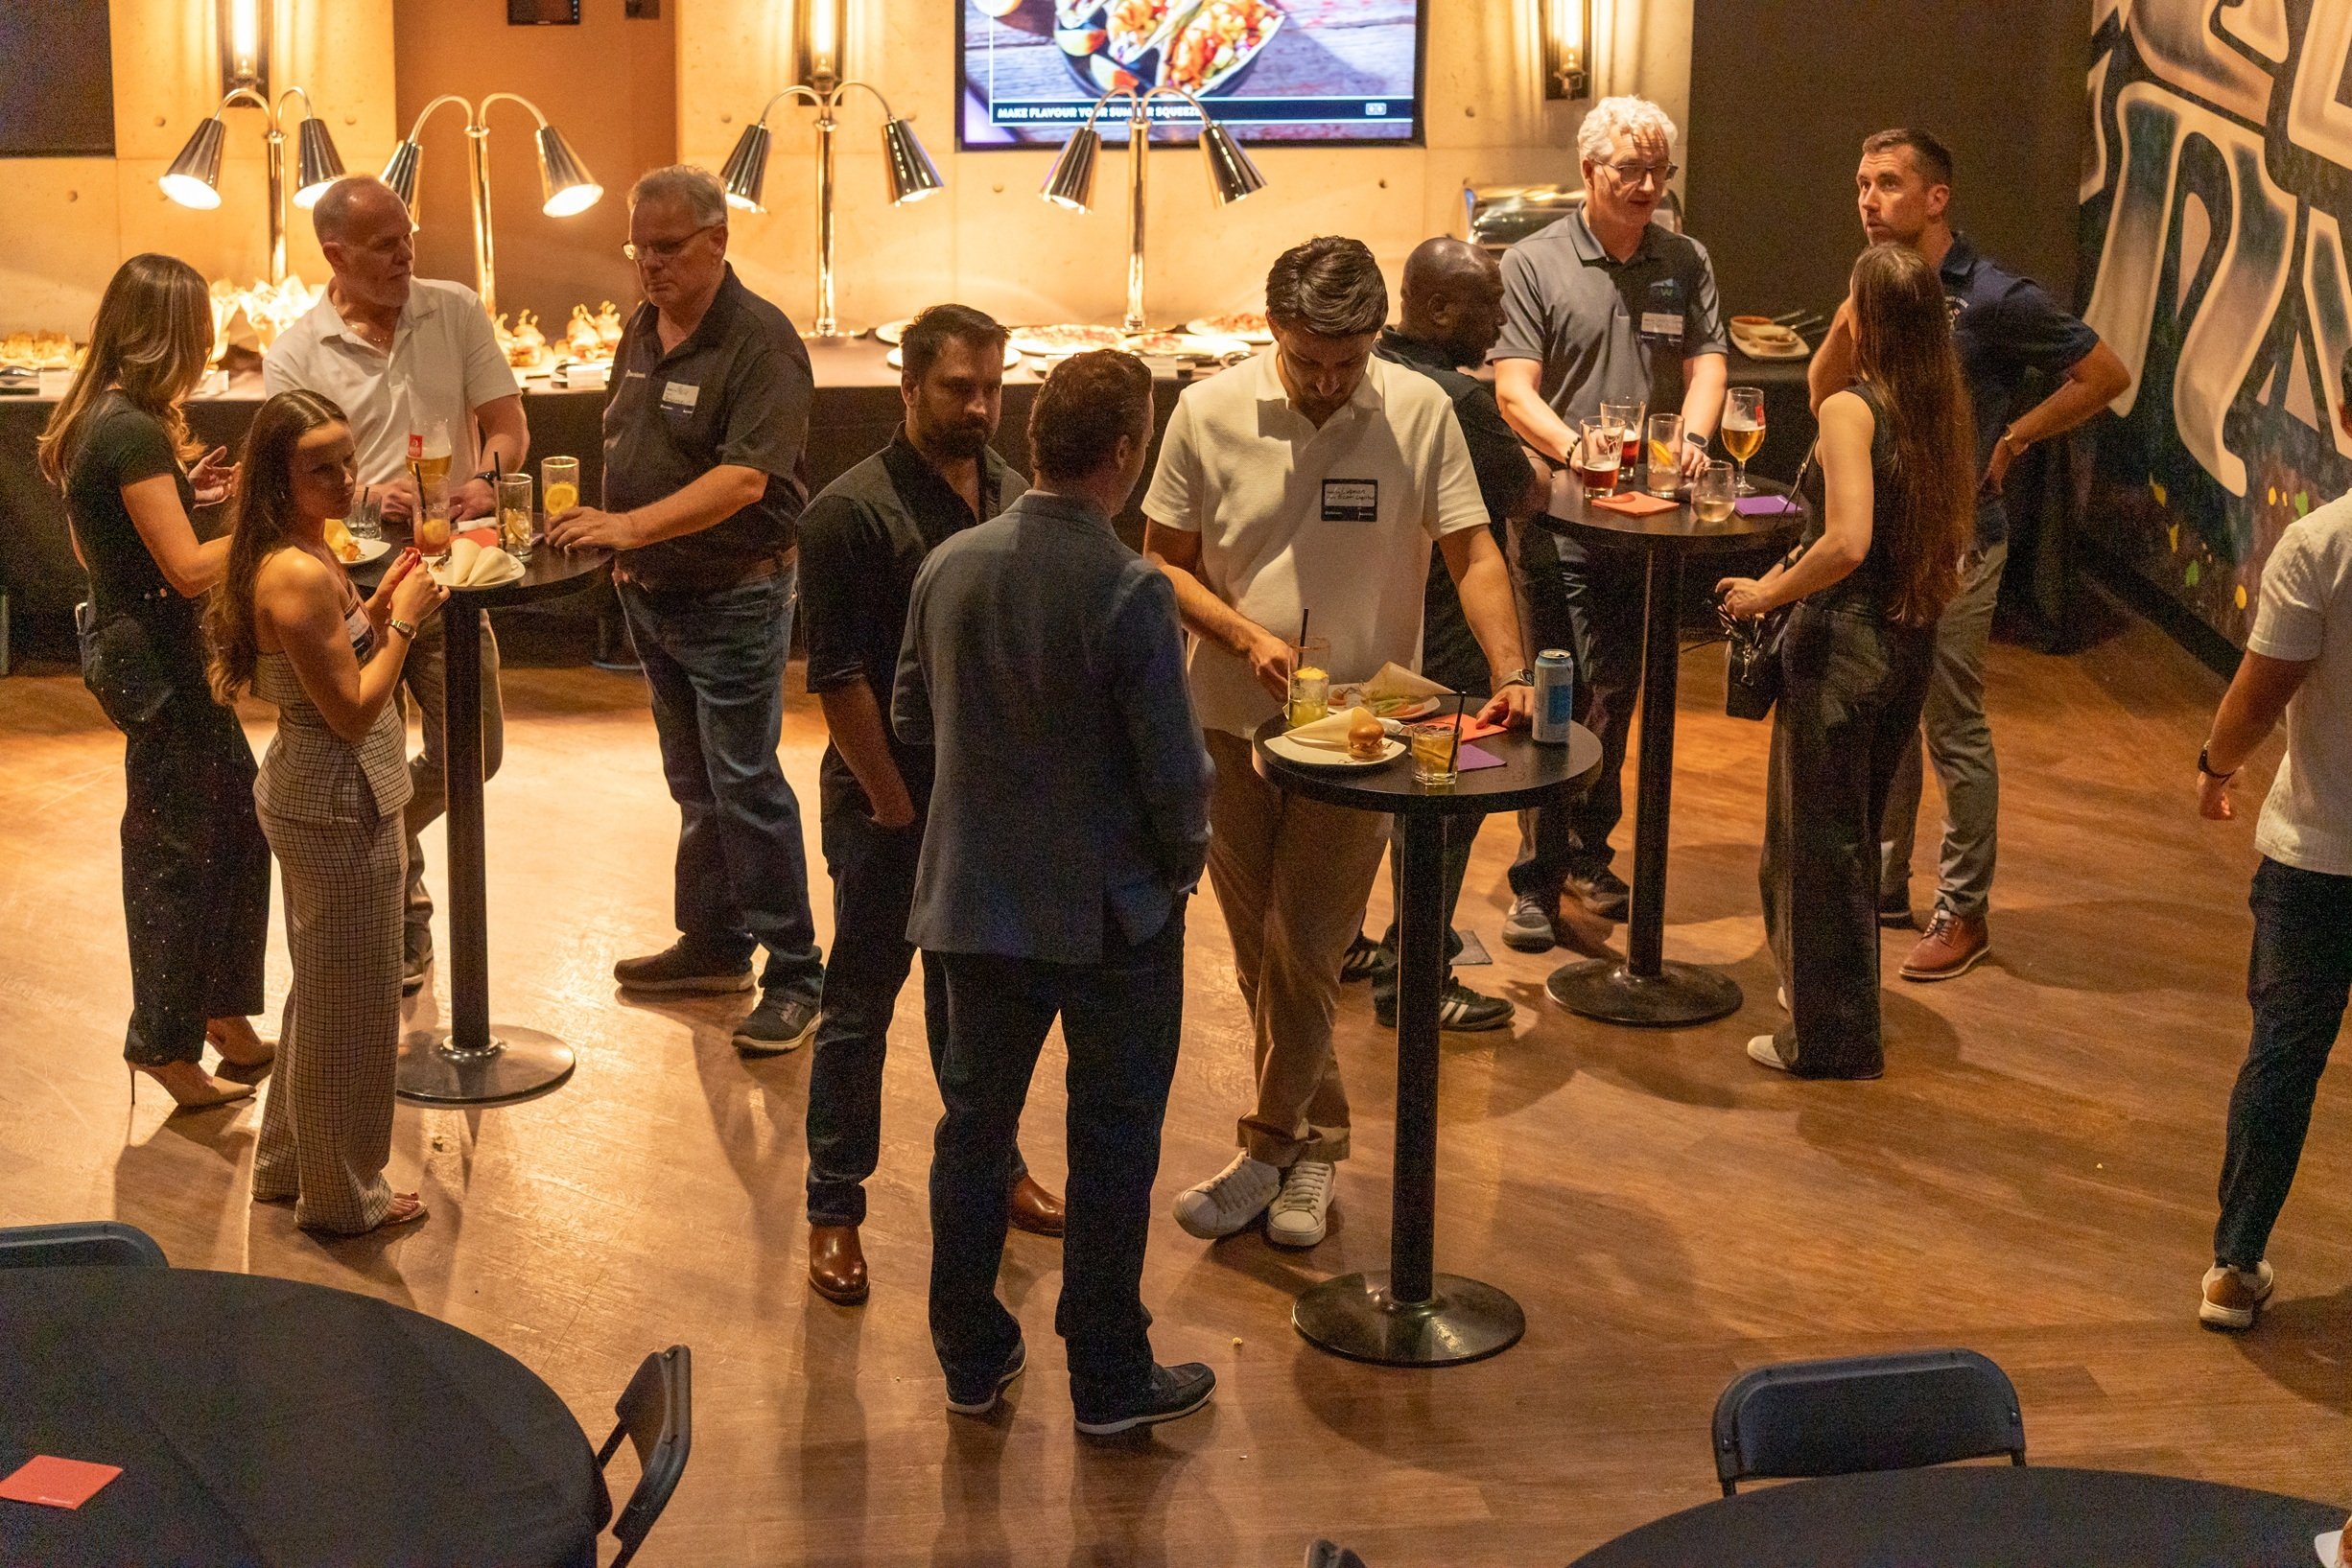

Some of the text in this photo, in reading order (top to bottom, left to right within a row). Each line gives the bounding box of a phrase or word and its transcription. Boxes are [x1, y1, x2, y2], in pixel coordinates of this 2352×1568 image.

[998, 107, 1028, 118] MAKE
[1029, 107, 1077, 118] FLAVOUR
[1109, 106, 1154, 117] SUMR
